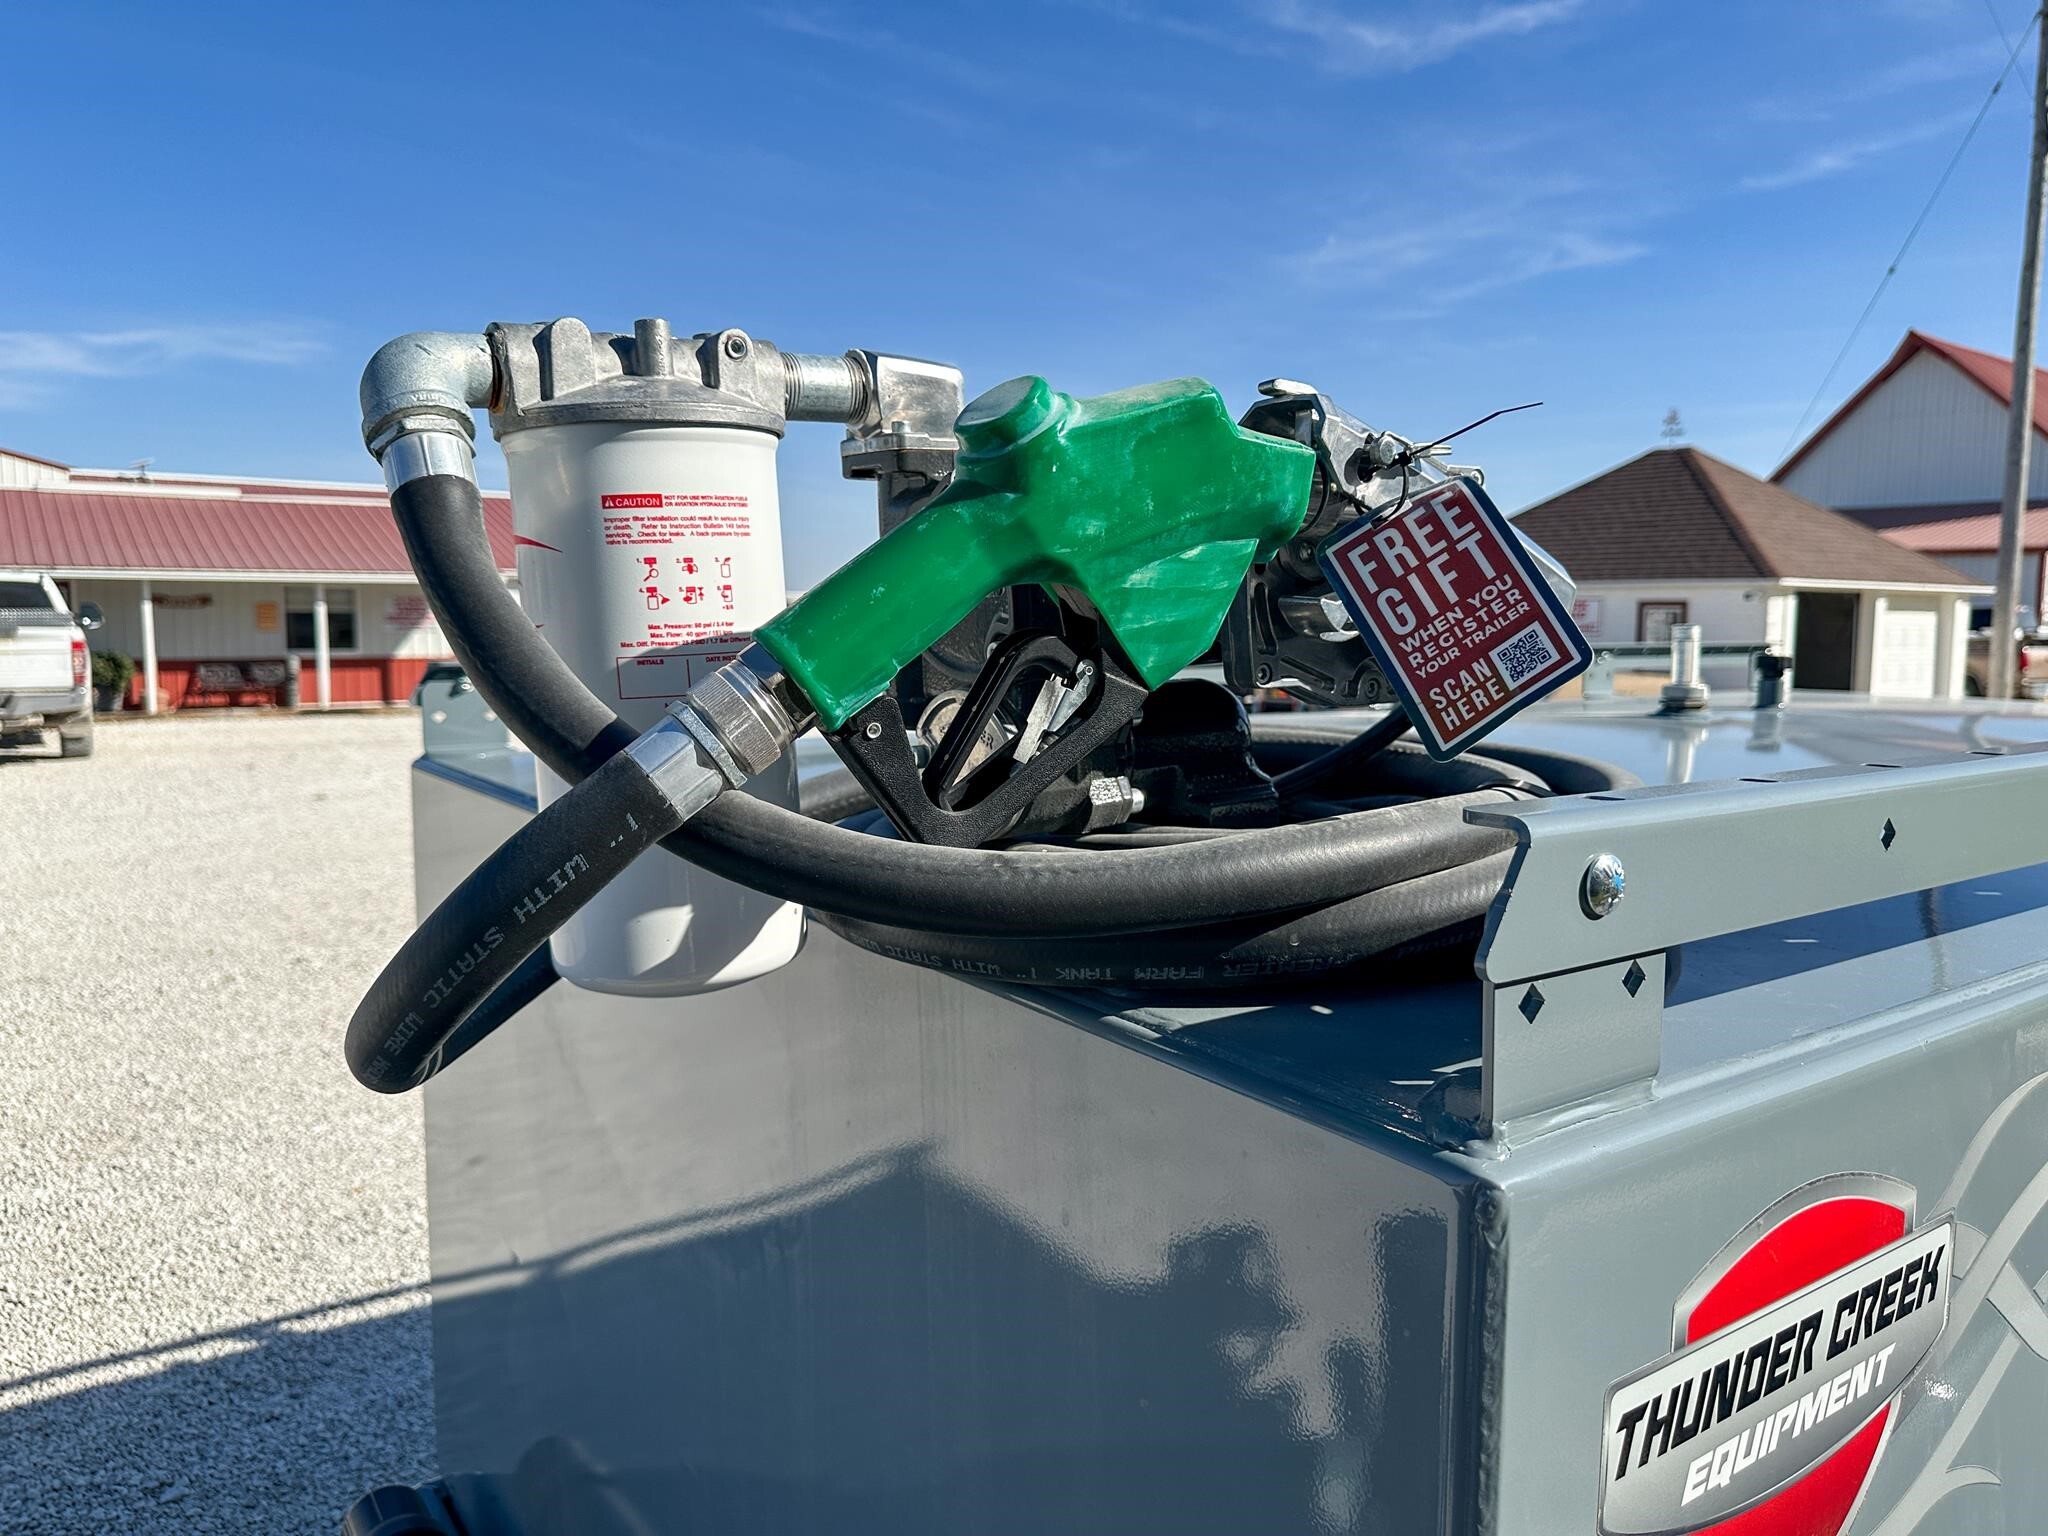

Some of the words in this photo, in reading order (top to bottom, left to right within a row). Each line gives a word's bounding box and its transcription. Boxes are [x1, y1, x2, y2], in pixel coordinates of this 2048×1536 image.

[615, 497, 660, 506] CAUTION
[1347, 490, 1476, 595] FREE
[1376, 530, 1497, 635] GIFT
[1399, 607, 1465, 654] WHEN
[1466, 574, 1513, 609] YOU
[1408, 588, 1524, 669] REGISTER
[1415, 648, 1462, 680] YOUR
[1462, 600, 1532, 650] TRAILER
[636, 658, 664, 666] INITIALS
[1428, 657, 1493, 710] SCAN
[1440, 677, 1505, 732] HERE
[513, 853, 589, 924] WITH
[423, 926, 504, 1009] STATIC
[885, 945, 943, 967] STATIC
[952, 958, 1001, 977] WITH
[1055, 967, 1115, 980] TANK
[1134, 966, 1205, 980] FARM
[384, 1011, 425, 1056] WIRE
[1615, 1309, 1824, 1482] THUNDER
[1825, 1244, 1946, 1362] CREEK
[1680, 1342, 1897, 1507] EQUIPMENT
